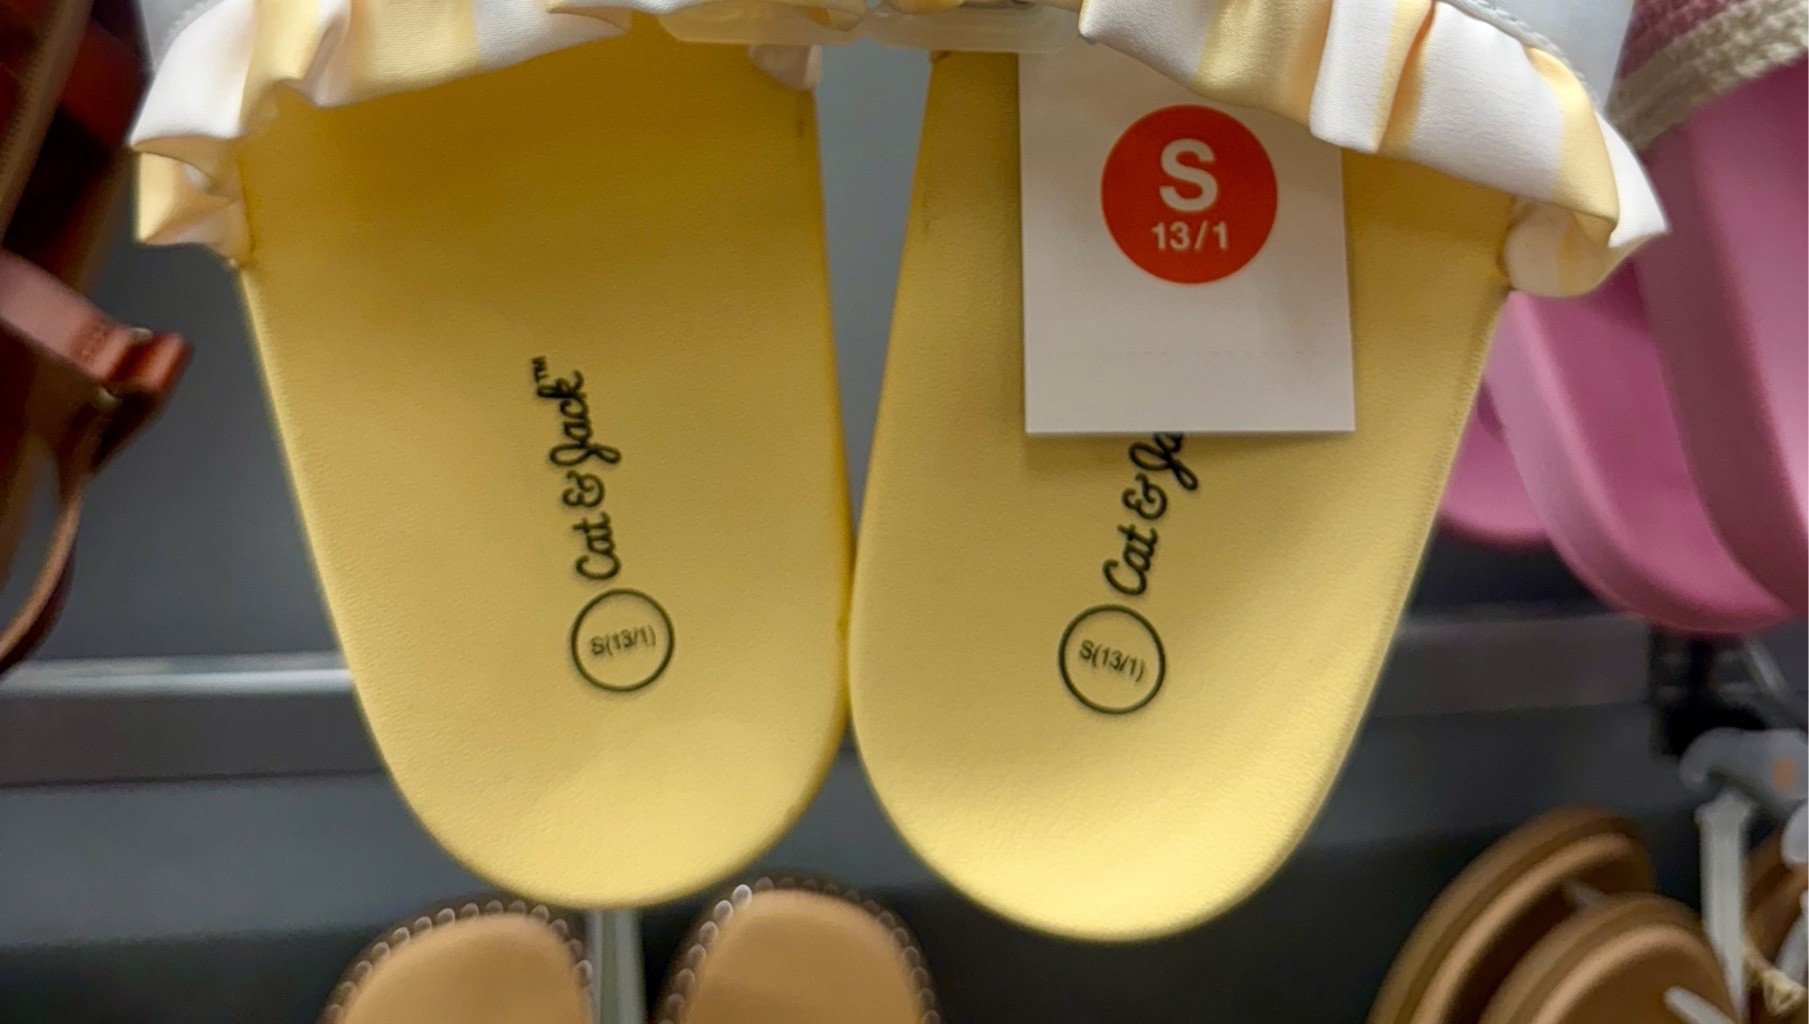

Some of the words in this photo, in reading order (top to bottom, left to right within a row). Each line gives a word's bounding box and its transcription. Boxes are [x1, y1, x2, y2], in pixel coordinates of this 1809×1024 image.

[1159, 138, 1218, 213] S
[1151, 221, 1230, 252] 13/1
[1128, 431, 1199, 491] Ja
[561, 469, 605, 509] &
[1121, 473, 1168, 520] &
[573, 510, 622, 581] Cat
[1102, 524, 1159, 596] Cat
[589, 625, 657, 658] S(13/1)
[1078, 638, 1146, 683] S(13/1)
